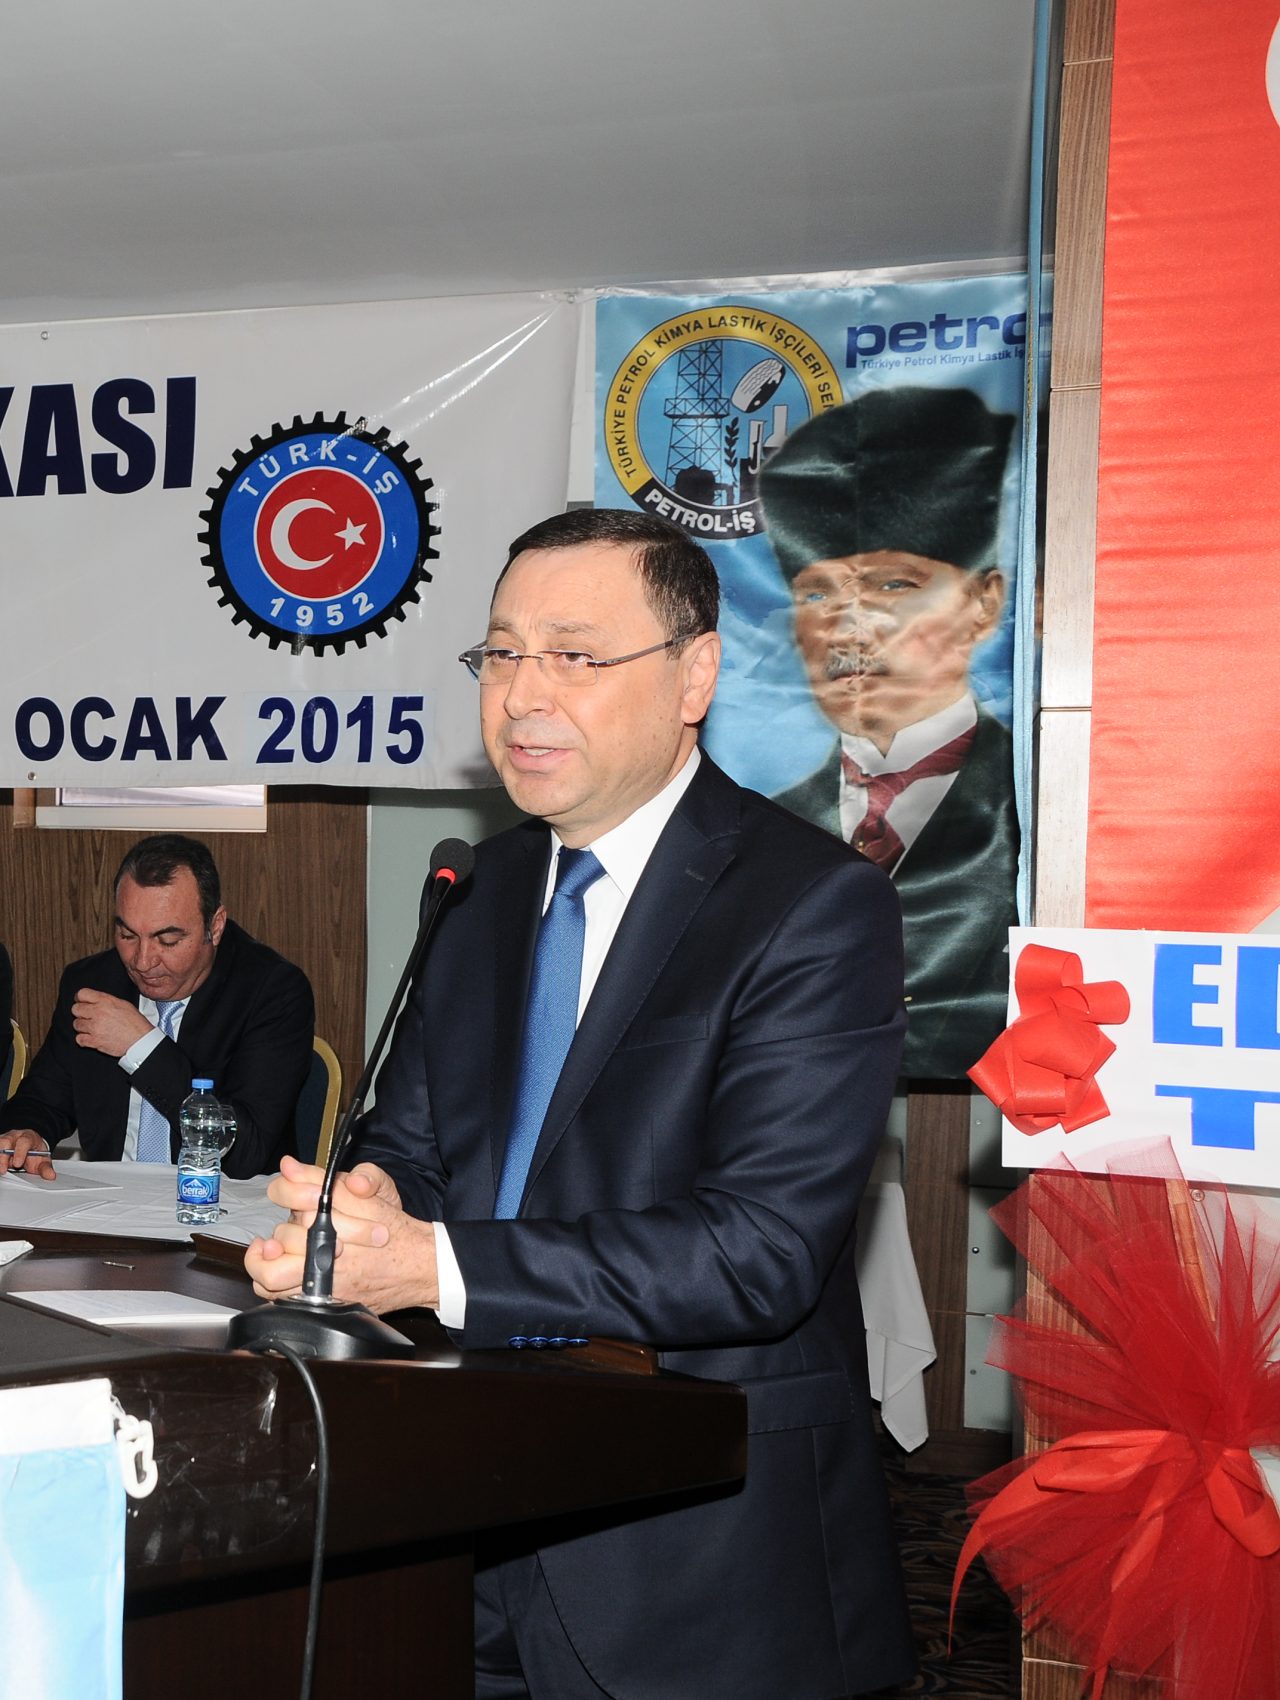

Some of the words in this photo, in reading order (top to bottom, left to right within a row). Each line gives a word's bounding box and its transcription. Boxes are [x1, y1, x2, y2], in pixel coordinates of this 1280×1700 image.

[655, 320, 703, 348] KİMYA
[708, 314, 766, 332] LASTİK
[770, 323, 826, 379] İŞÇİLERİ
[861, 358, 901, 370] Türkiye
[904, 355, 936, 367] Petrol
[941, 354, 974, 365] Kimya
[978, 349, 1012, 362] Lastik
[617, 349, 655, 404] PETROL
[613, 410, 637, 478] TÜRKİYE
[238, 440, 400, 495] TÜRK-İŞ
[644, 488, 756, 533] PETROL-İŞ
[270, 592, 374, 627] 1952
[16, 697, 227, 761] OCAK
[256, 696, 423, 764] 2015
[182, 1183, 209, 1196] berrak
